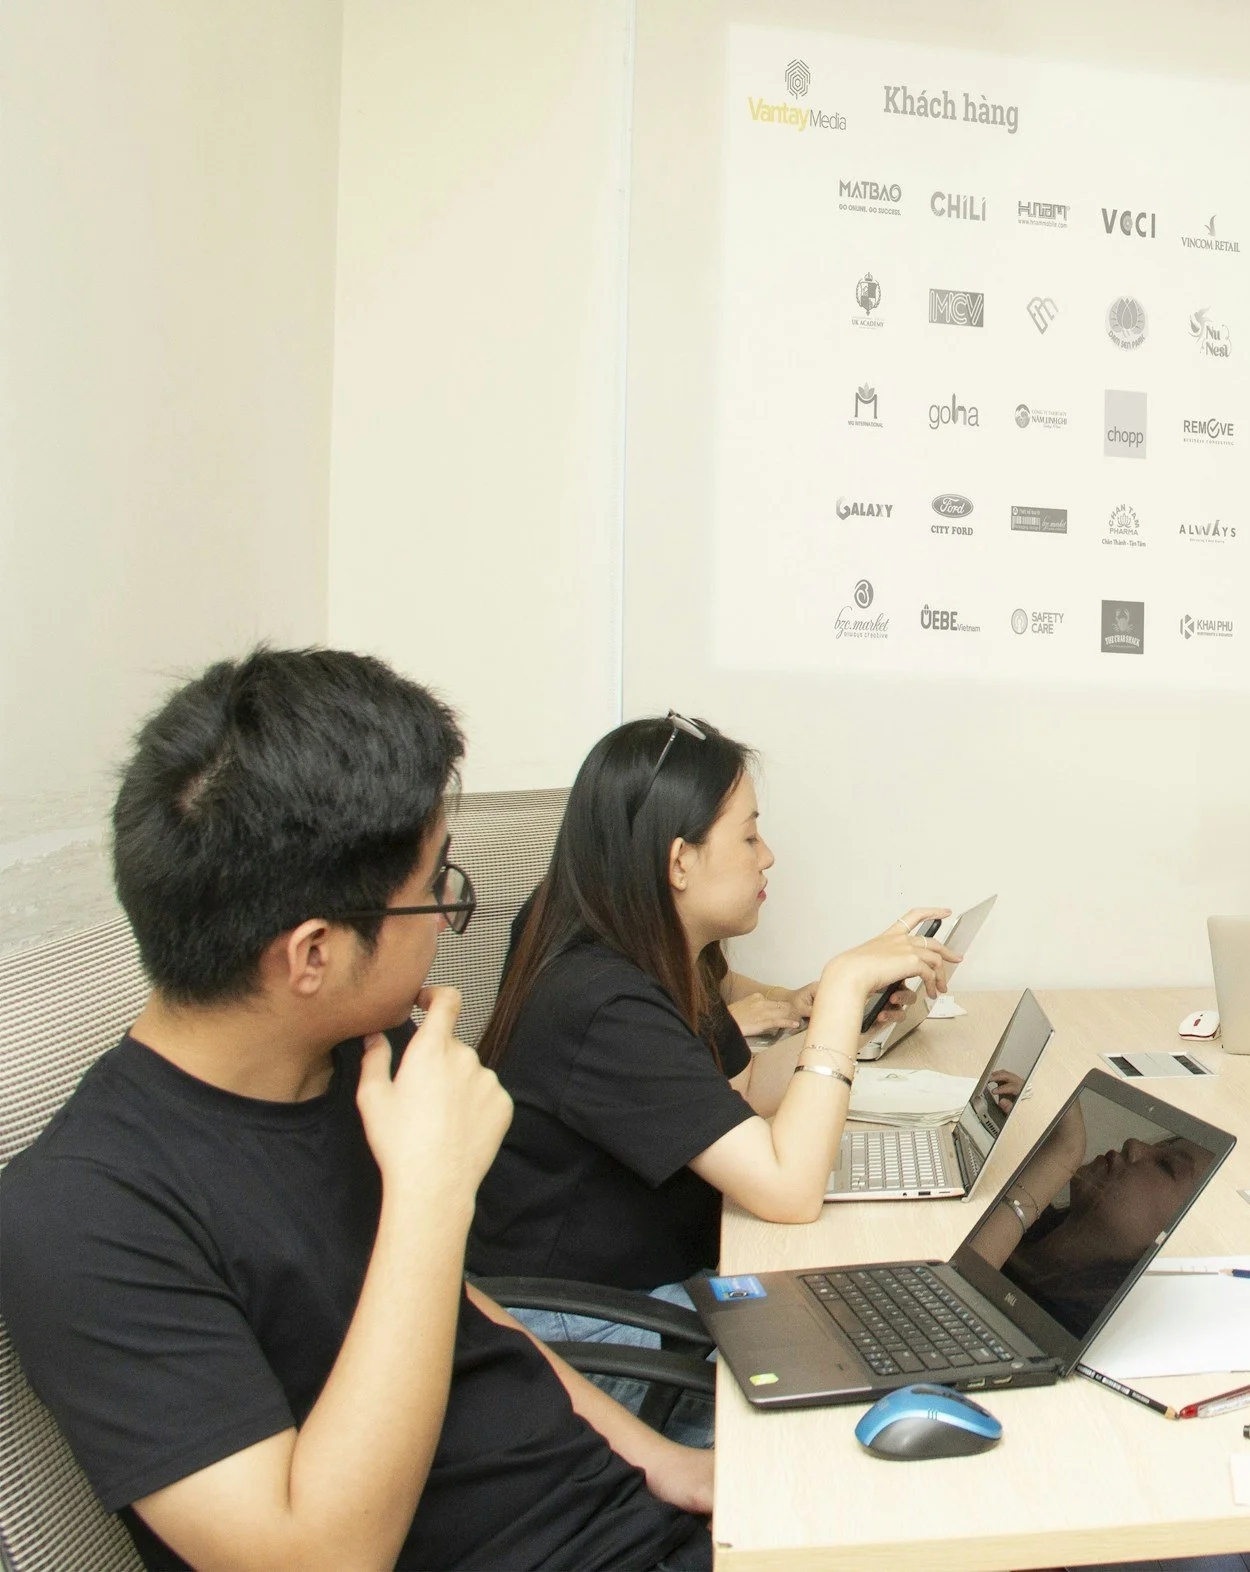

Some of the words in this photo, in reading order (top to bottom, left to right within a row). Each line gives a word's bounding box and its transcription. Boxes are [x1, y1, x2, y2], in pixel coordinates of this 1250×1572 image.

[883, 85, 957, 121] Khách
[963, 94, 1019, 134] hàng
[838, 179, 902, 202] MATBAO
[1101, 208, 1156, 239] VCCI
[1181, 236, 1214, 250] VINCOM
[1214, 239, 1241, 253] RETAIL
[928, 393, 980, 430] goha
[1107, 426, 1144, 448] chopp
[1183, 418, 1234, 439] REMOVE
[836, 496, 893, 521] GALAXY
[939, 497, 966, 514] Ford
[930, 524, 950, 535] CITY
[951, 525, 974, 536] FORD
[1109, 527, 1139, 536] PHARMA
[1179, 519, 1236, 538] ALWAYS
[1031, 611, 1065, 624] SAFETY
[1196, 619, 1216, 631] KHAI
[1031, 622, 1054, 635] CARE
